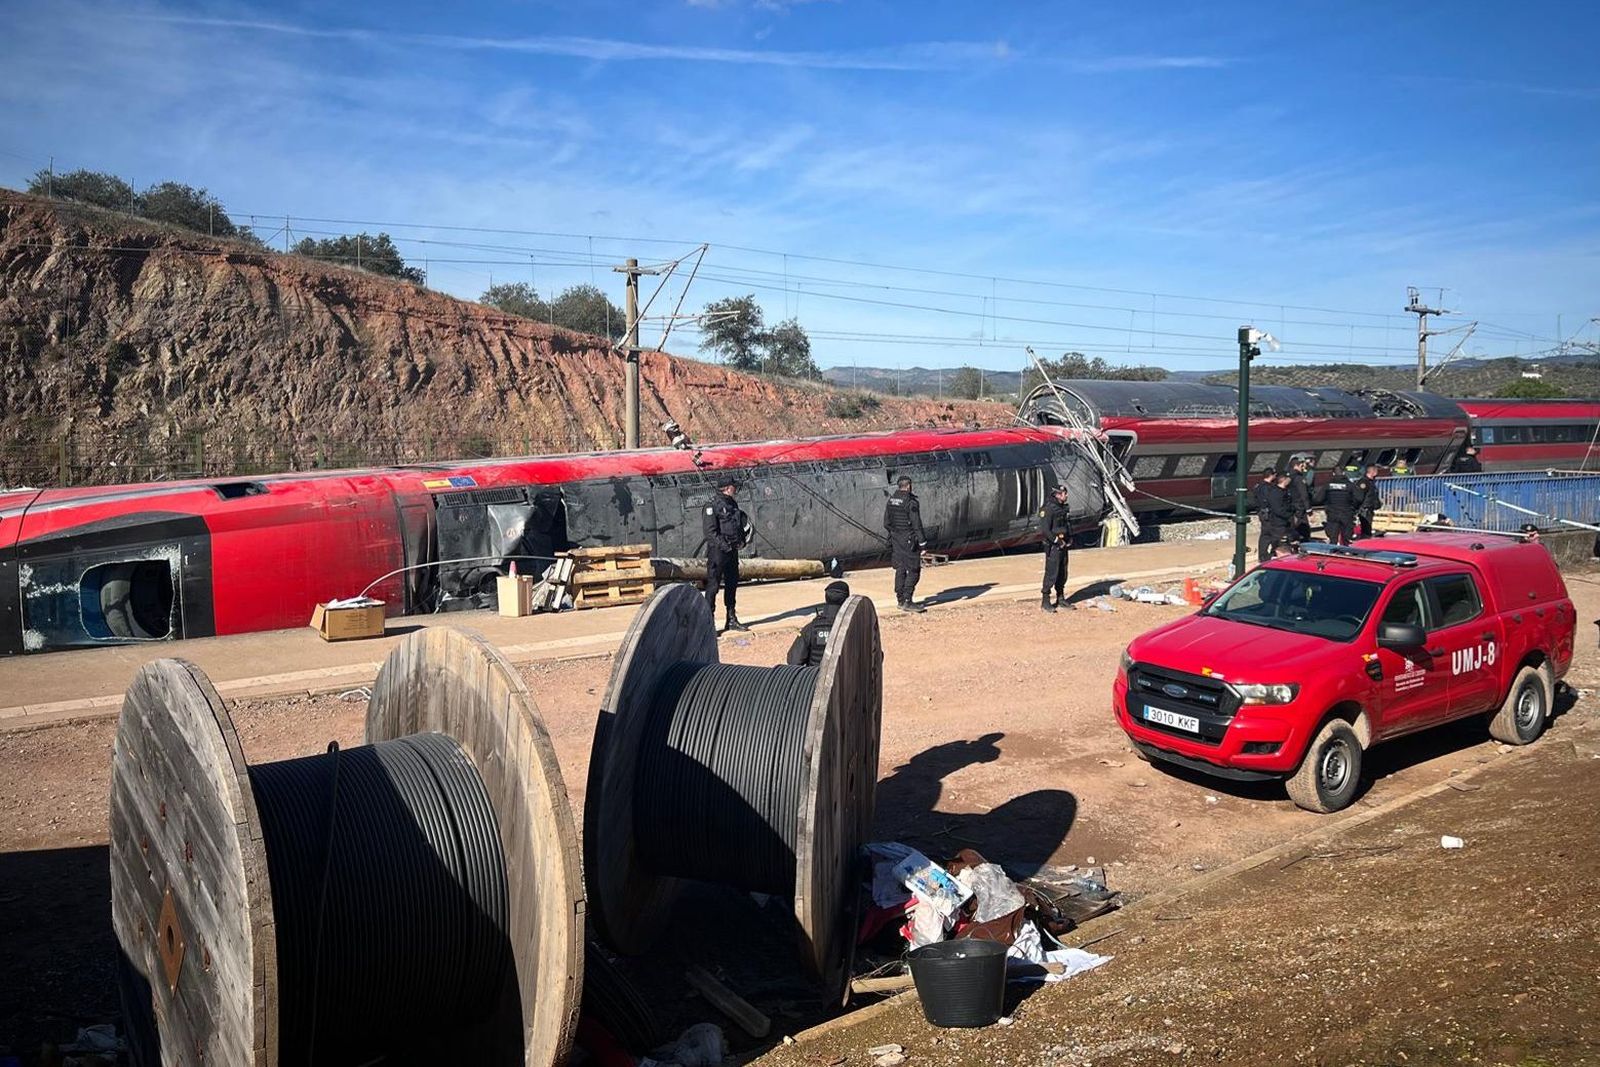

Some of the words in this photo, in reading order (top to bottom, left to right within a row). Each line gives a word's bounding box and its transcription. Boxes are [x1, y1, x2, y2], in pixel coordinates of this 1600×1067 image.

[1452, 641, 1495, 676] UMJ-8
[1151, 709, 1174, 725] 3010
[1178, 716, 1197, 729] KKF
